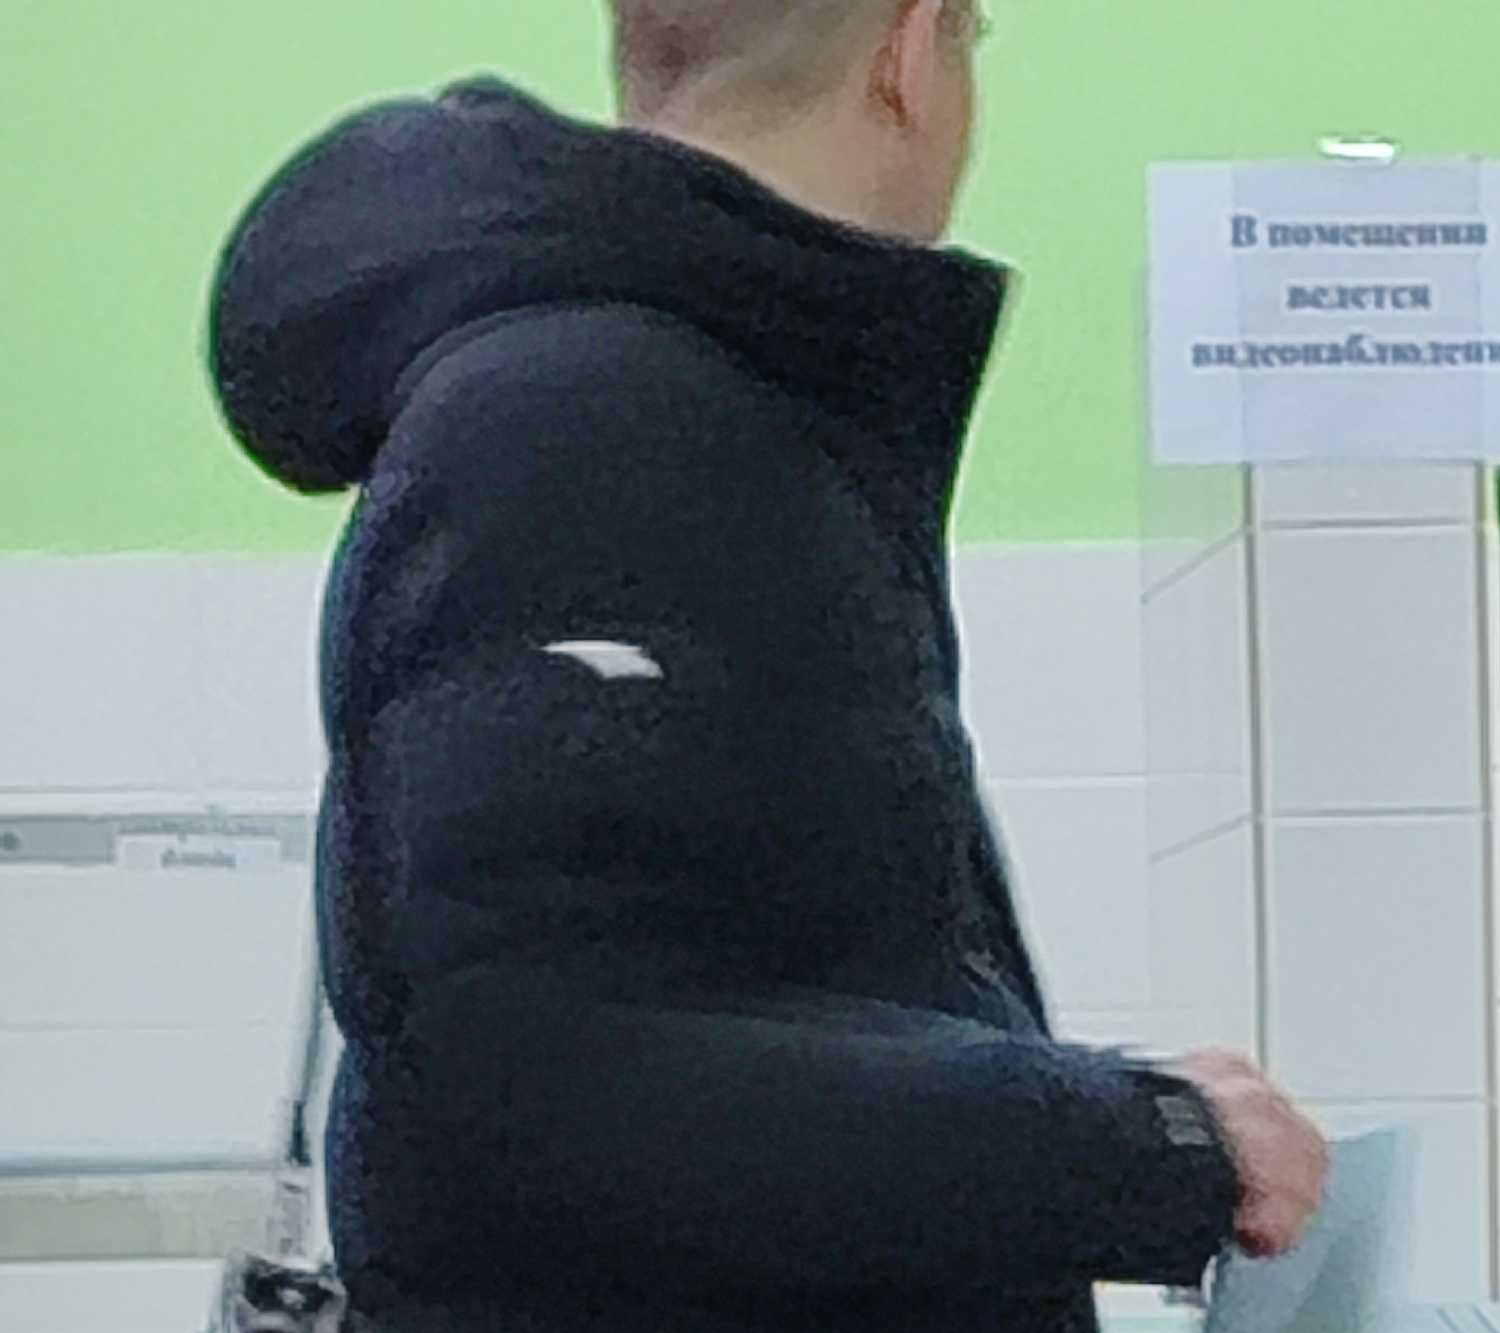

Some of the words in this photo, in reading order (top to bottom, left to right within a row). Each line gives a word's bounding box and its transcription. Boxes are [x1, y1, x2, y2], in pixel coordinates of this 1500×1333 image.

[1229, 214, 1257, 248] В
[1267, 222, 1488, 249] помещении
[1286, 284, 1432, 311] ведется
